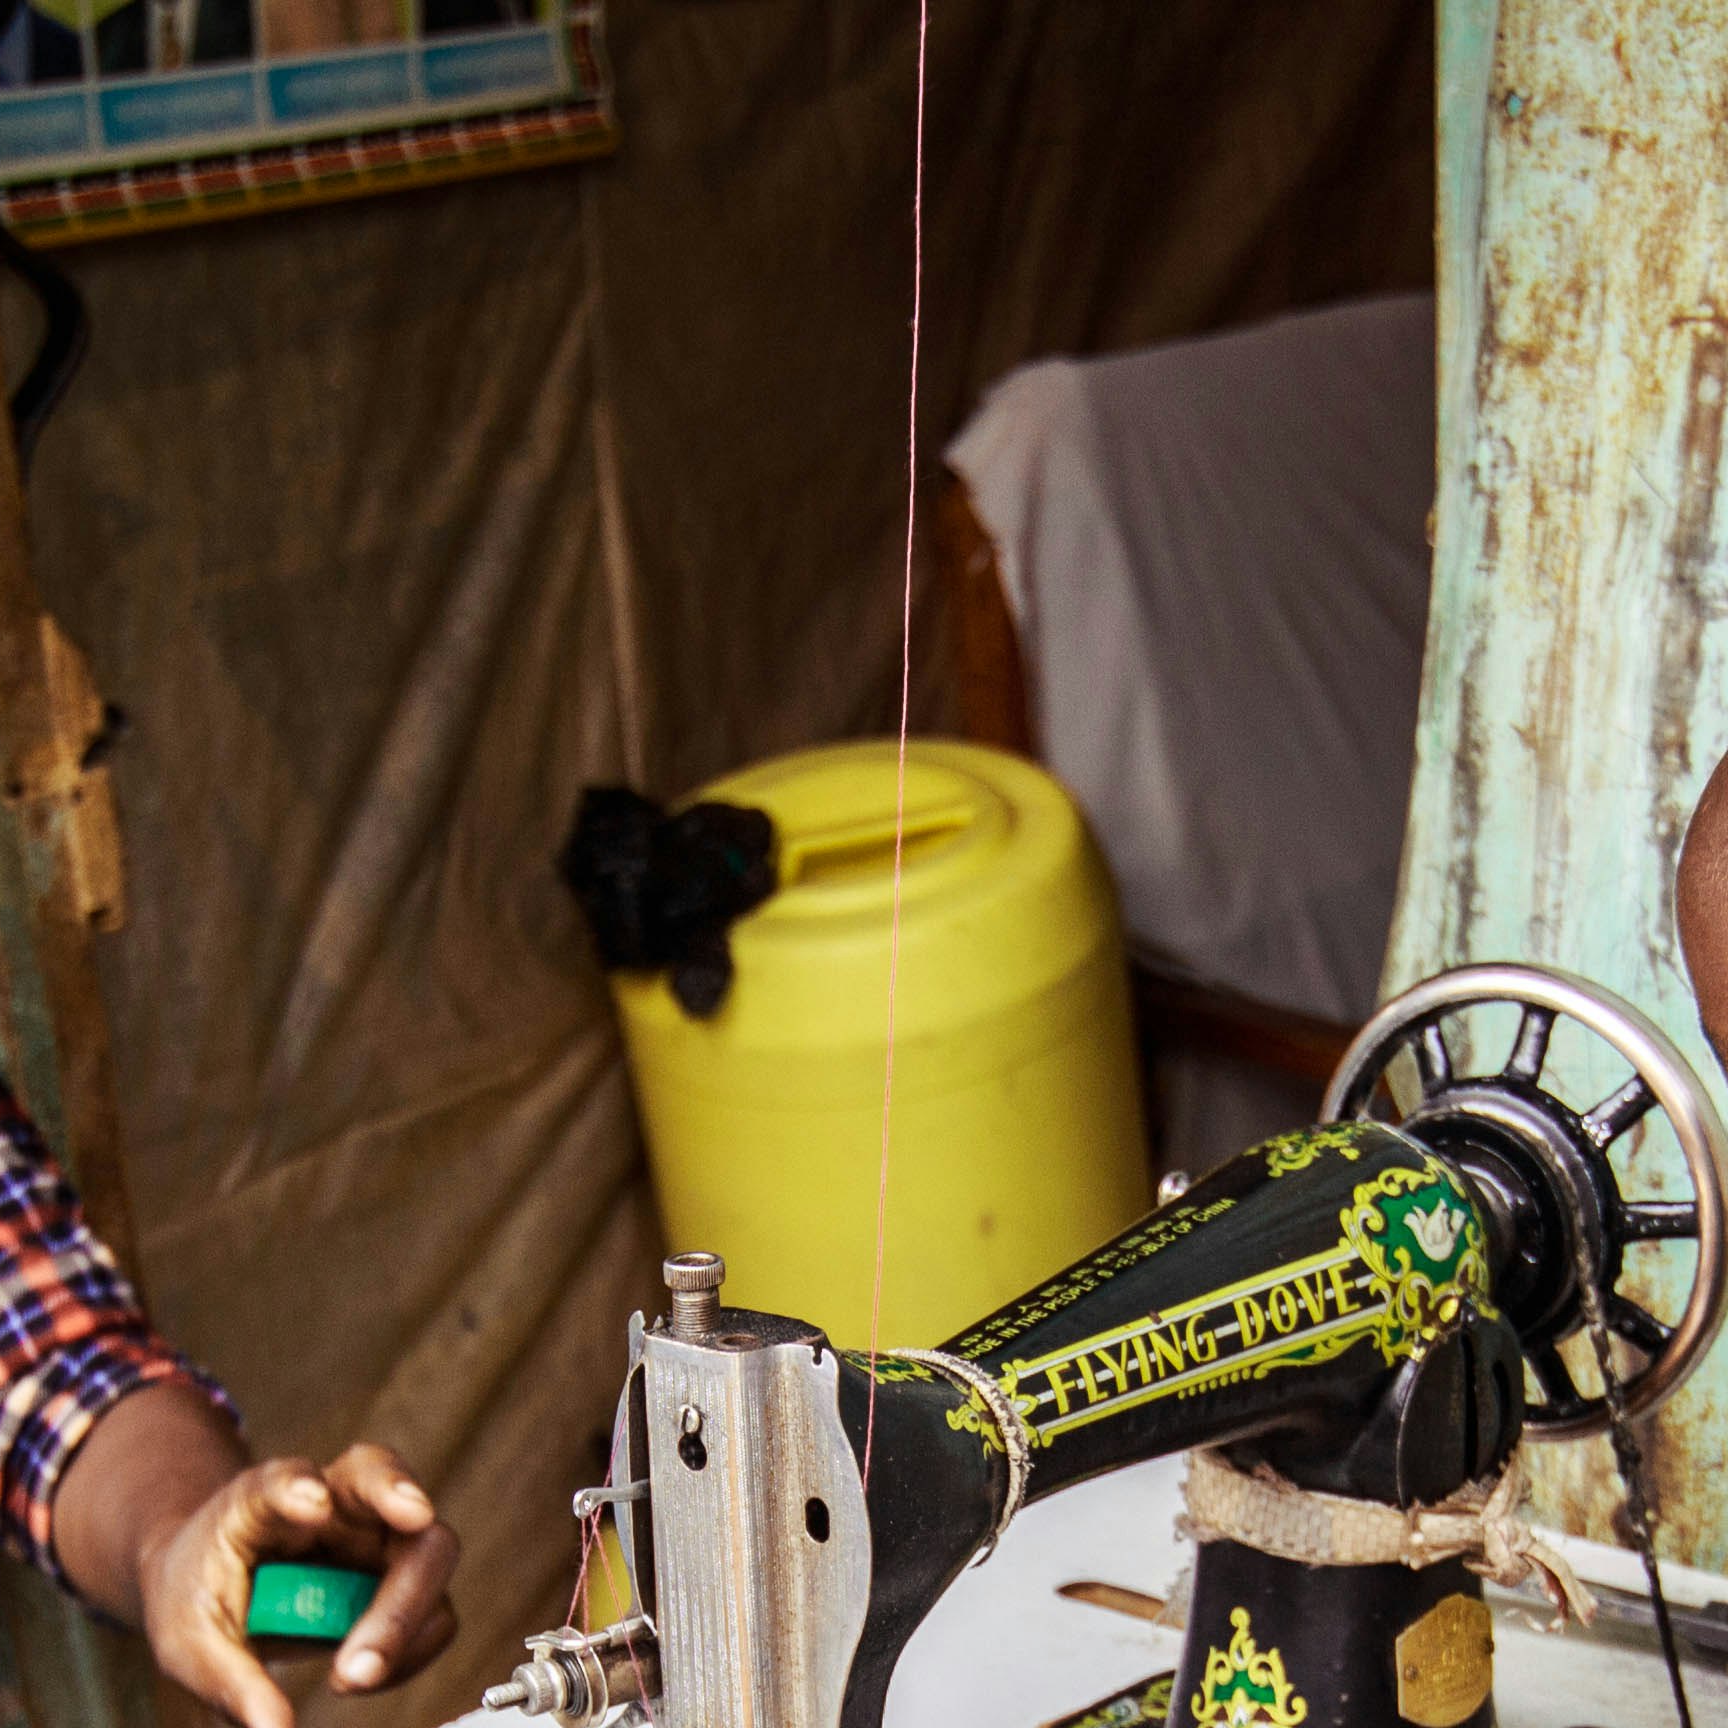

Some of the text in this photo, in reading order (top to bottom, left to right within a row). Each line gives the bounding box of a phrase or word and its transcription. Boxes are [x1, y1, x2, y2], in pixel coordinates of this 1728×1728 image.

[999, 1325, 1021, 1339] IN
[1015, 1309, 1049, 1330] THE
[1172, 1220, 1193, 1234] OF
[1192, 1197, 1238, 1223] CHINA
[1045, 1261, 1361, 1415] FLYING DOVE
